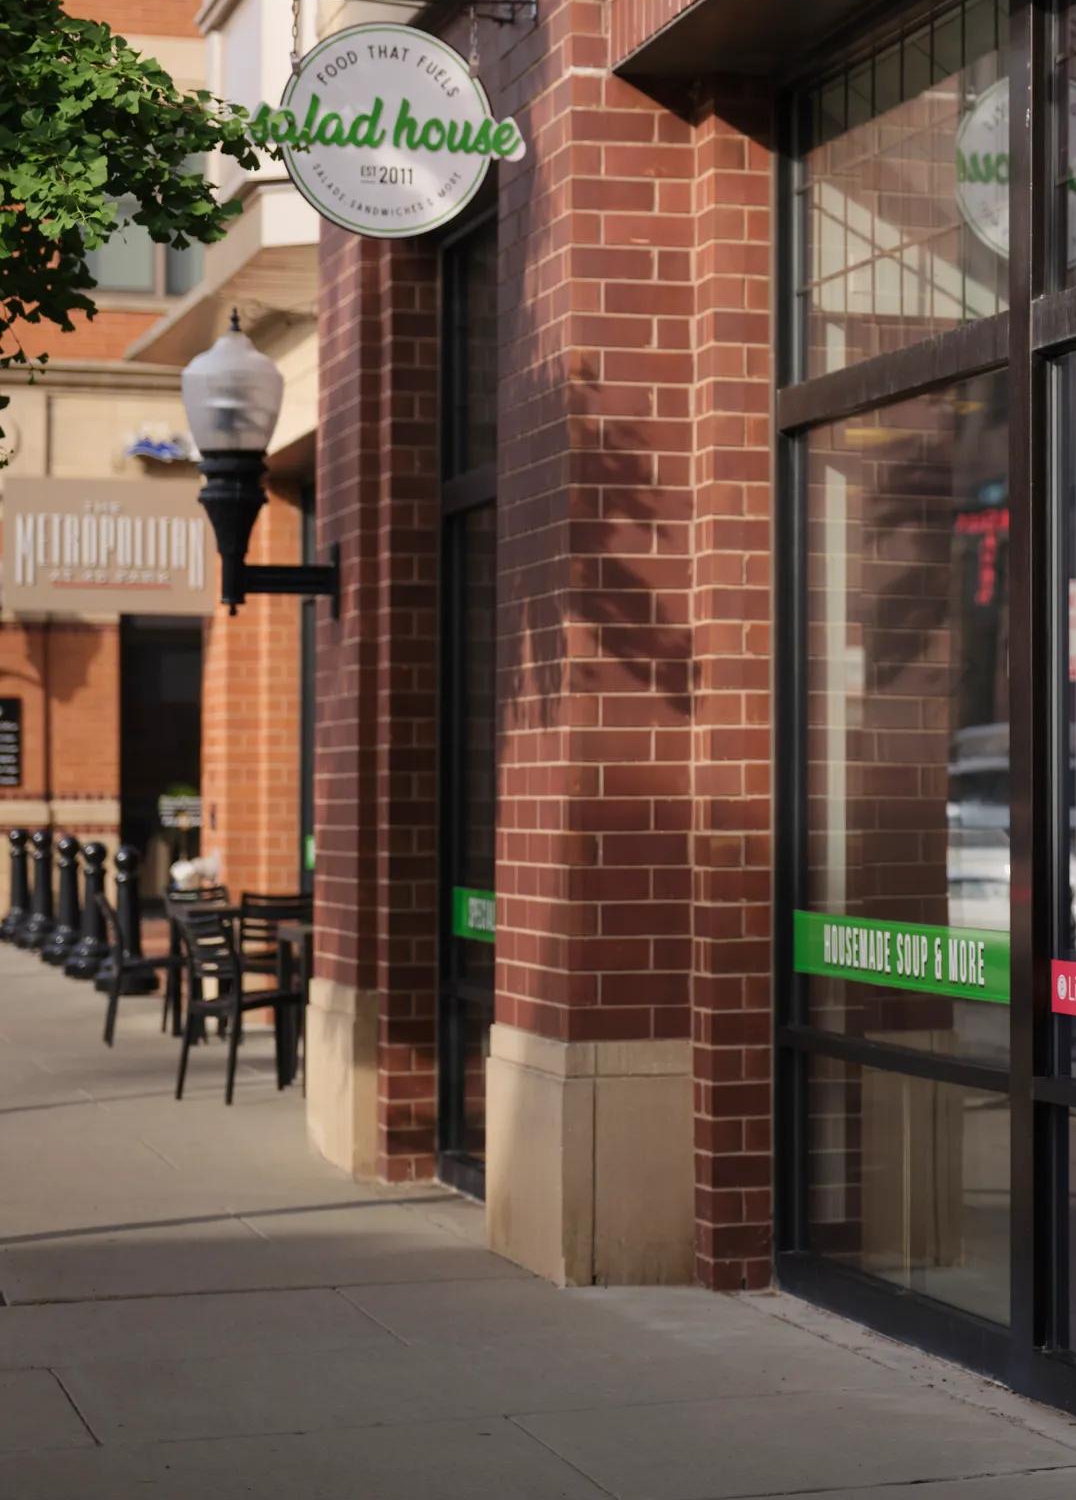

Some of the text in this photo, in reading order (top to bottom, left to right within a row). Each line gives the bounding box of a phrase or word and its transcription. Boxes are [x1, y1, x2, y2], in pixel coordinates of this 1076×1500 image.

[316, 45, 460, 99] FOOD THAT FUELS
[250, 93, 521, 156] salad house
[350, 200, 424, 217] SANDWICHES
[437, 171, 463, 199] MORE
[379, 166, 413, 185] 2011
[15, 513, 204, 588] METROPOLITAN
[824, 924, 985, 985] HOUSEMADE SOUP & MORE
